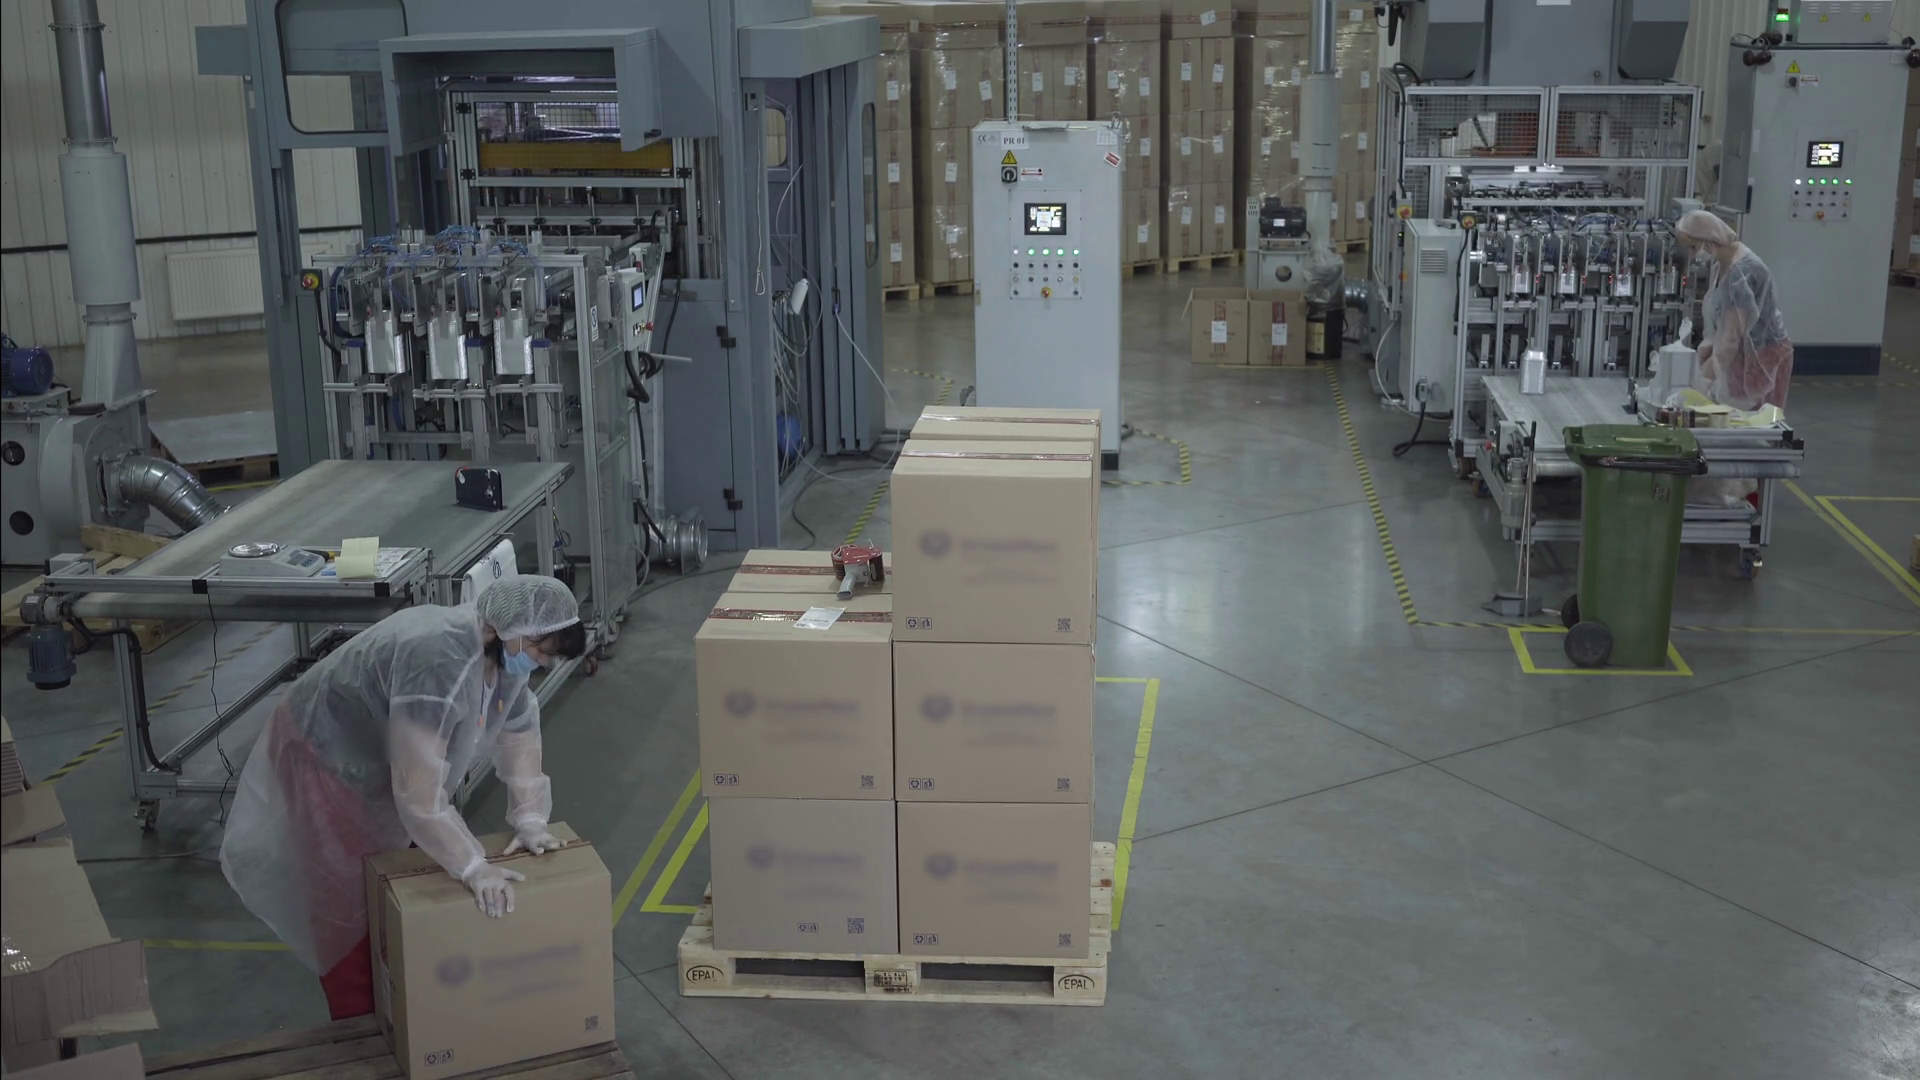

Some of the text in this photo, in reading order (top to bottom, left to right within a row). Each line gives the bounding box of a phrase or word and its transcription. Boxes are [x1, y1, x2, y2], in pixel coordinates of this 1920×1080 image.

[1003, 137, 1025, 145] PR 01
[1064, 978, 1089, 990] EPAL
